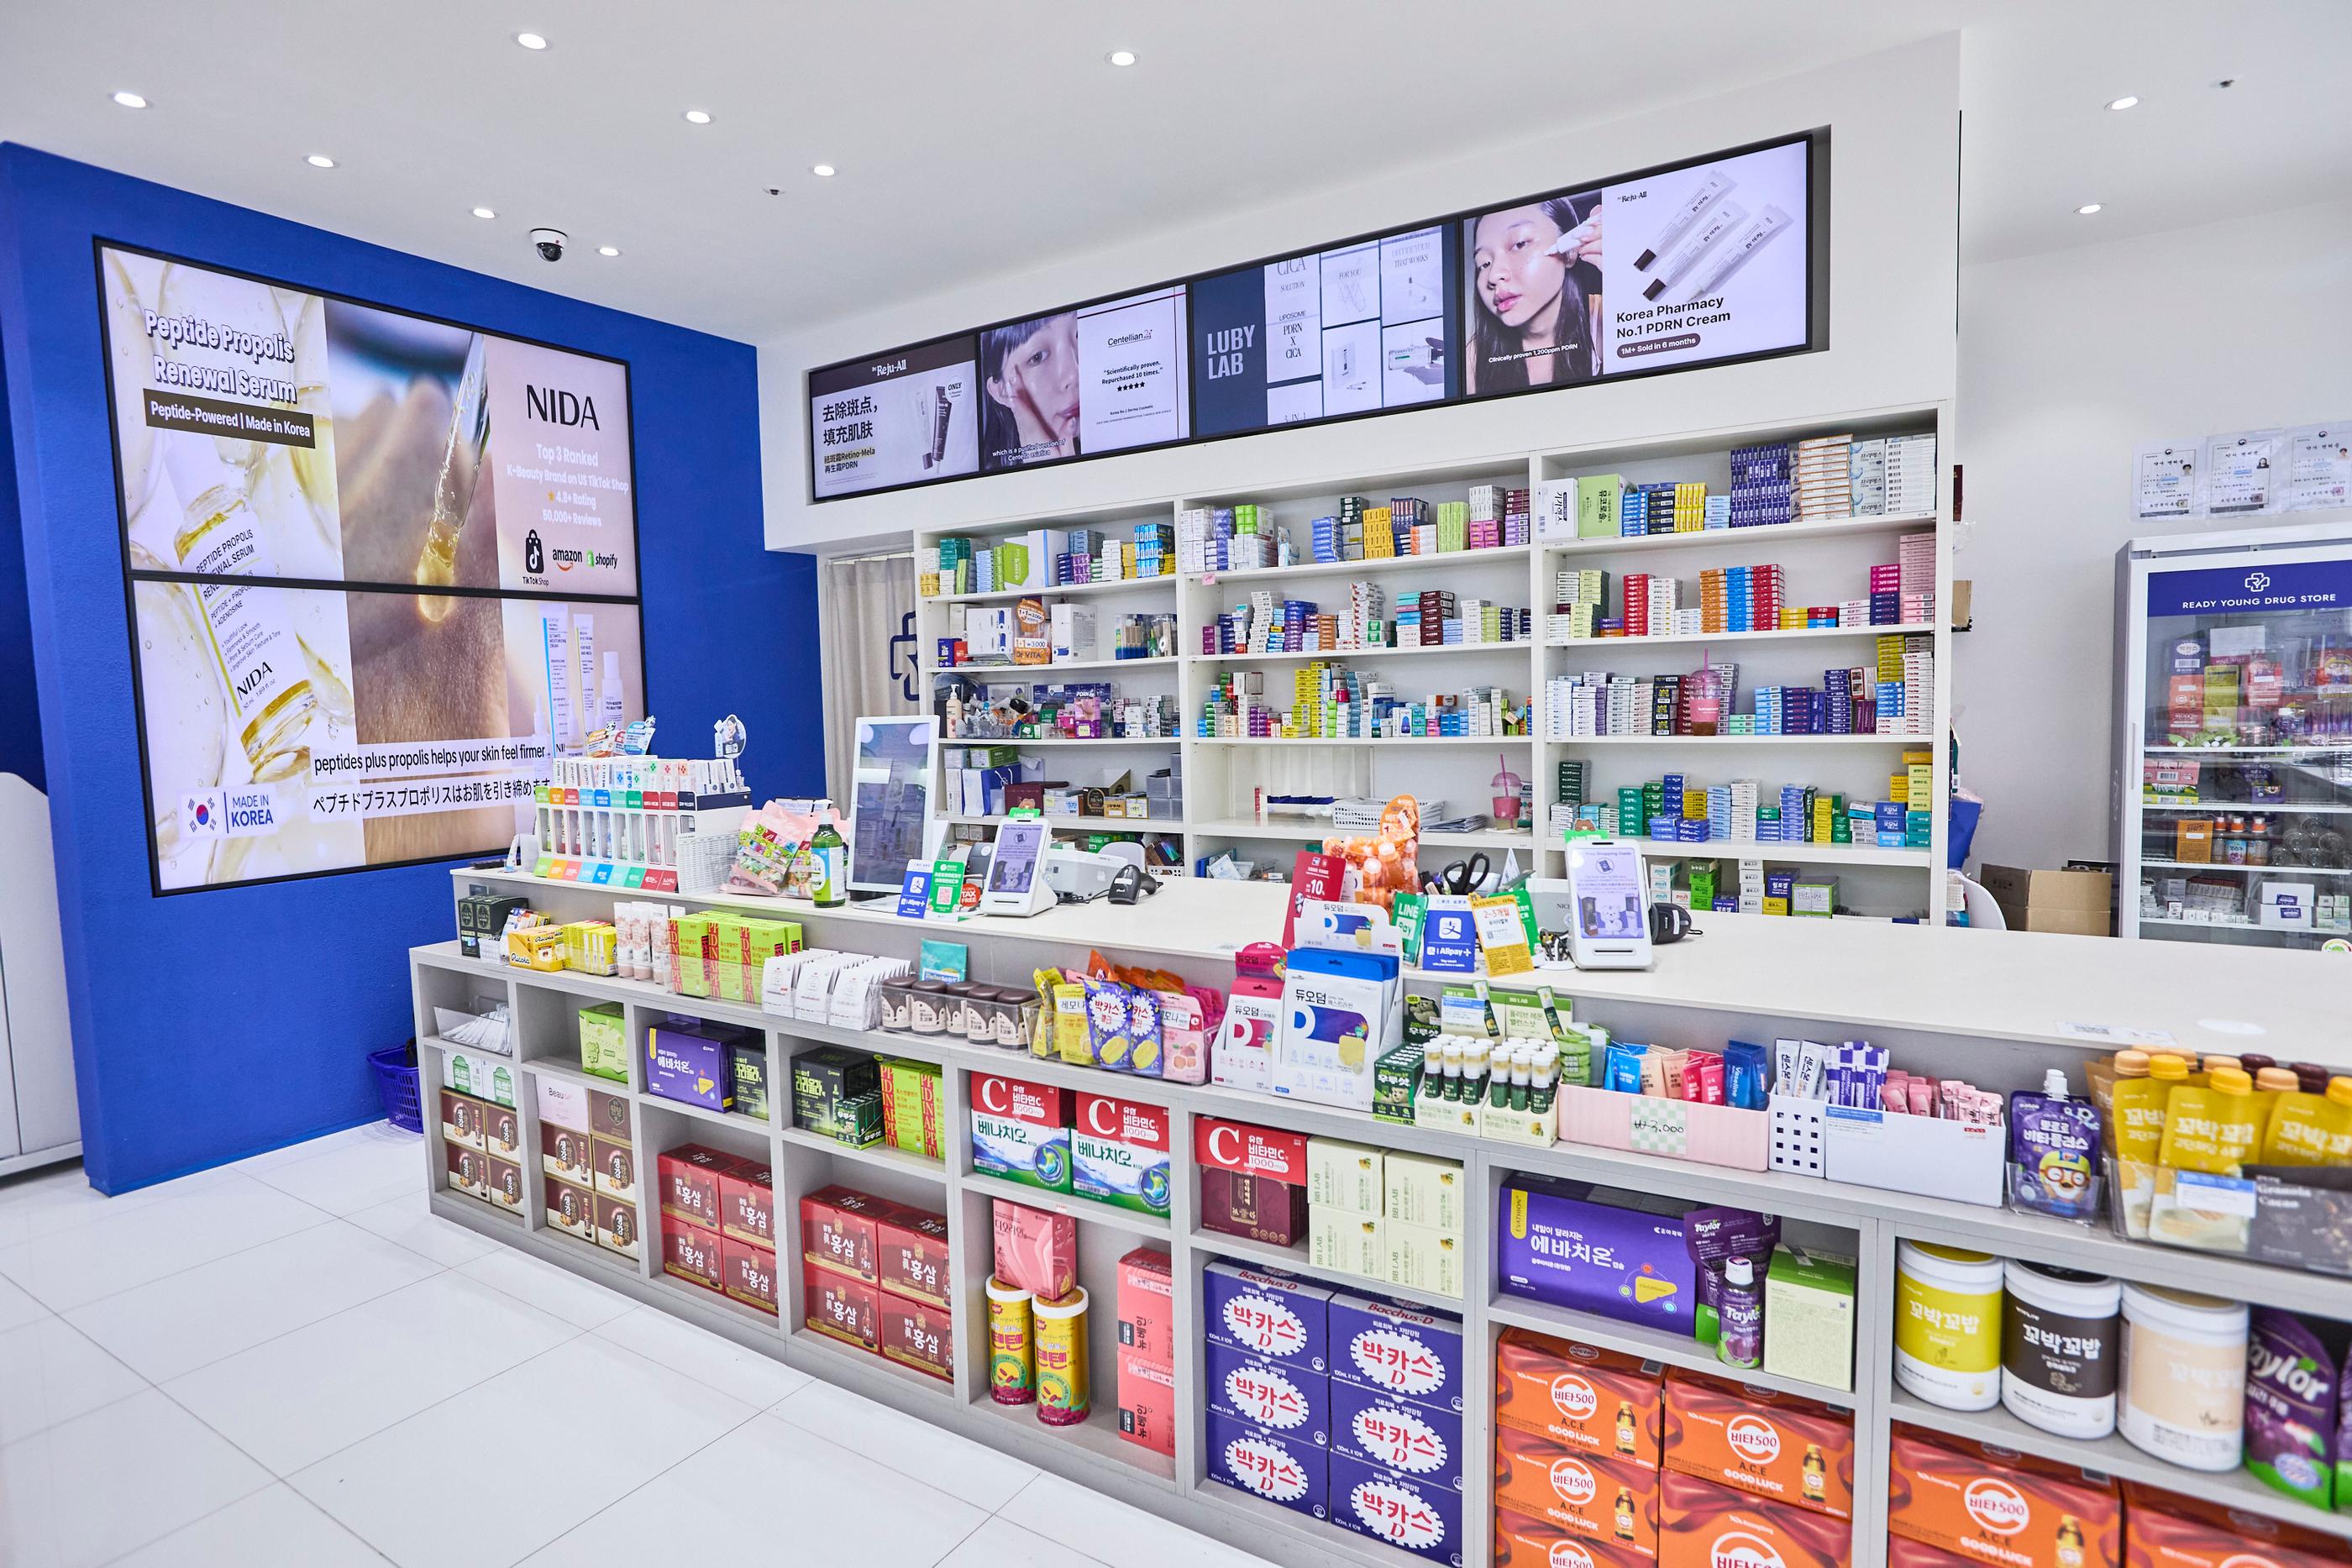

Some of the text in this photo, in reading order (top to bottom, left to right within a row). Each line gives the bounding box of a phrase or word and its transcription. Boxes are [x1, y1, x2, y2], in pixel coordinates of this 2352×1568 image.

[1394, 254, 1429, 268] THAT WORKS
[1278, 311, 1307, 322] LIPOSOME
[1616, 296, 1725, 323] Korea Pharmacy
[1284, 323, 1303, 336] PDRN
[1616, 312, 1730, 338] No.1 PDRN Cream
[144, 309, 295, 364] Peptide Propolis
[1207, 324, 1255, 355] LUBY
[1621, 347, 1636, 355] 1M+
[1637, 343, 1652, 353] Sold
[1668, 337, 1696, 346] months
[1285, 348, 1302, 359] CICA
[1488, 343, 1578, 363] Clinically proven 1,200ppm PDRN
[877, 359, 906, 375] Reju-All
[1208, 353, 1243, 380] LAB
[153, 354, 297, 404] Renewal Serum
[948, 382, 963, 391] ONLY
[1101, 373, 1135, 385] Repurchased
[526, 385, 600, 431] NIDA
[150, 401, 311, 438] Peptide-Powered Made in Korea
[823, 421, 873, 446] 填充肌肤
[1038, 441, 1058, 449] version
[1058, 438, 1066, 447] of
[537, 443, 599, 467] Top 3 Ranked
[1009, 453, 1030, 462] Centella
[507, 464, 629, 495] K-Beauty Brand on US TikTok Shop
[556, 490, 596, 511] 4.8+ Rating
[543, 508, 602, 527] 50,000+ Reviews
[196, 528, 254, 574] PEPTIDE PROPOLIS
[232, 543, 255, 563] SERUM
[552, 548, 618, 569] amazon shopify
[522, 576, 549, 586] TikTok Shop
[211, 600, 228, 621] PEPTIDE
[2182, 593, 2336, 609] READY YOUNG DRUG STORE
[239, 621, 249, 634] Look
[226, 622, 261, 656] Firmness Smooth
[229, 651, 238, 663] Pore
[254, 631, 264, 643] Care
[246, 648, 255, 658] Skin
[255, 637, 269, 652] Texture
[272, 630, 281, 640] Tone
[236, 661, 273, 700] NIDA
[314, 744, 545, 776] peptides plus propolis helps your skin feel firmer
[233, 794, 269, 808] MADE IN
[231, 809, 273, 827] KOREA
[1323, 903, 1344, 913] 듀오덤
[1399, 903, 1419, 918] LINE
[510, 952, 531, 965] Ricola
[1236, 952, 1259, 965] 듀오덤
[1095, 1000, 1120, 1015] 박카스
[1295, 989, 1326, 1005] 듀오덤
[658, 1056, 690, 1074] 에바치온
[1012, 1084, 1026, 1094] 유한
[1732, 1066, 1741, 1098] Vaseline
[981, 1078, 1007, 1113] C
[1012, 1093, 1042, 1107] 비타민C
[1122, 1115, 1156, 1130] 비타민C
[1123, 1107, 1137, 1118] 유한
[978, 1120, 1026, 1145] 베나치오
[2023, 1130, 2089, 1150] 비타플러스
[1078, 1141, 1132, 1167] 베나치오
[681, 1185, 701, 1209] 홍삼
[746, 1207, 767, 1229] 홍삼
[1695, 1219, 1721, 1233] Taylor
[1531, 1223, 1584, 1241] 내일이 달라지는
[830, 1235, 855, 1259] 홍삼
[1530, 1235, 1610, 1267] 에바치온
[1238, 1270, 1298, 1291] Bacchus-D
[1233, 1307, 1297, 1341] 박카스
[1368, 1303, 1435, 1325] Bacchus-D
[1909, 1299, 1979, 1334] 꼬박꼬밥
[1136, 1315, 1147, 1350] 뉴베인
[2023, 1322, 2101, 1359] 꼬박꼬밥
[1362, 1340, 1436, 1380] 박카스
[1236, 1377, 1299, 1414] 박카스
[1553, 1389, 1594, 1406] 비타500
[1548, 1424, 1599, 1447] GOOD LUCK
[1731, 1431, 1777, 1449] 비타500
